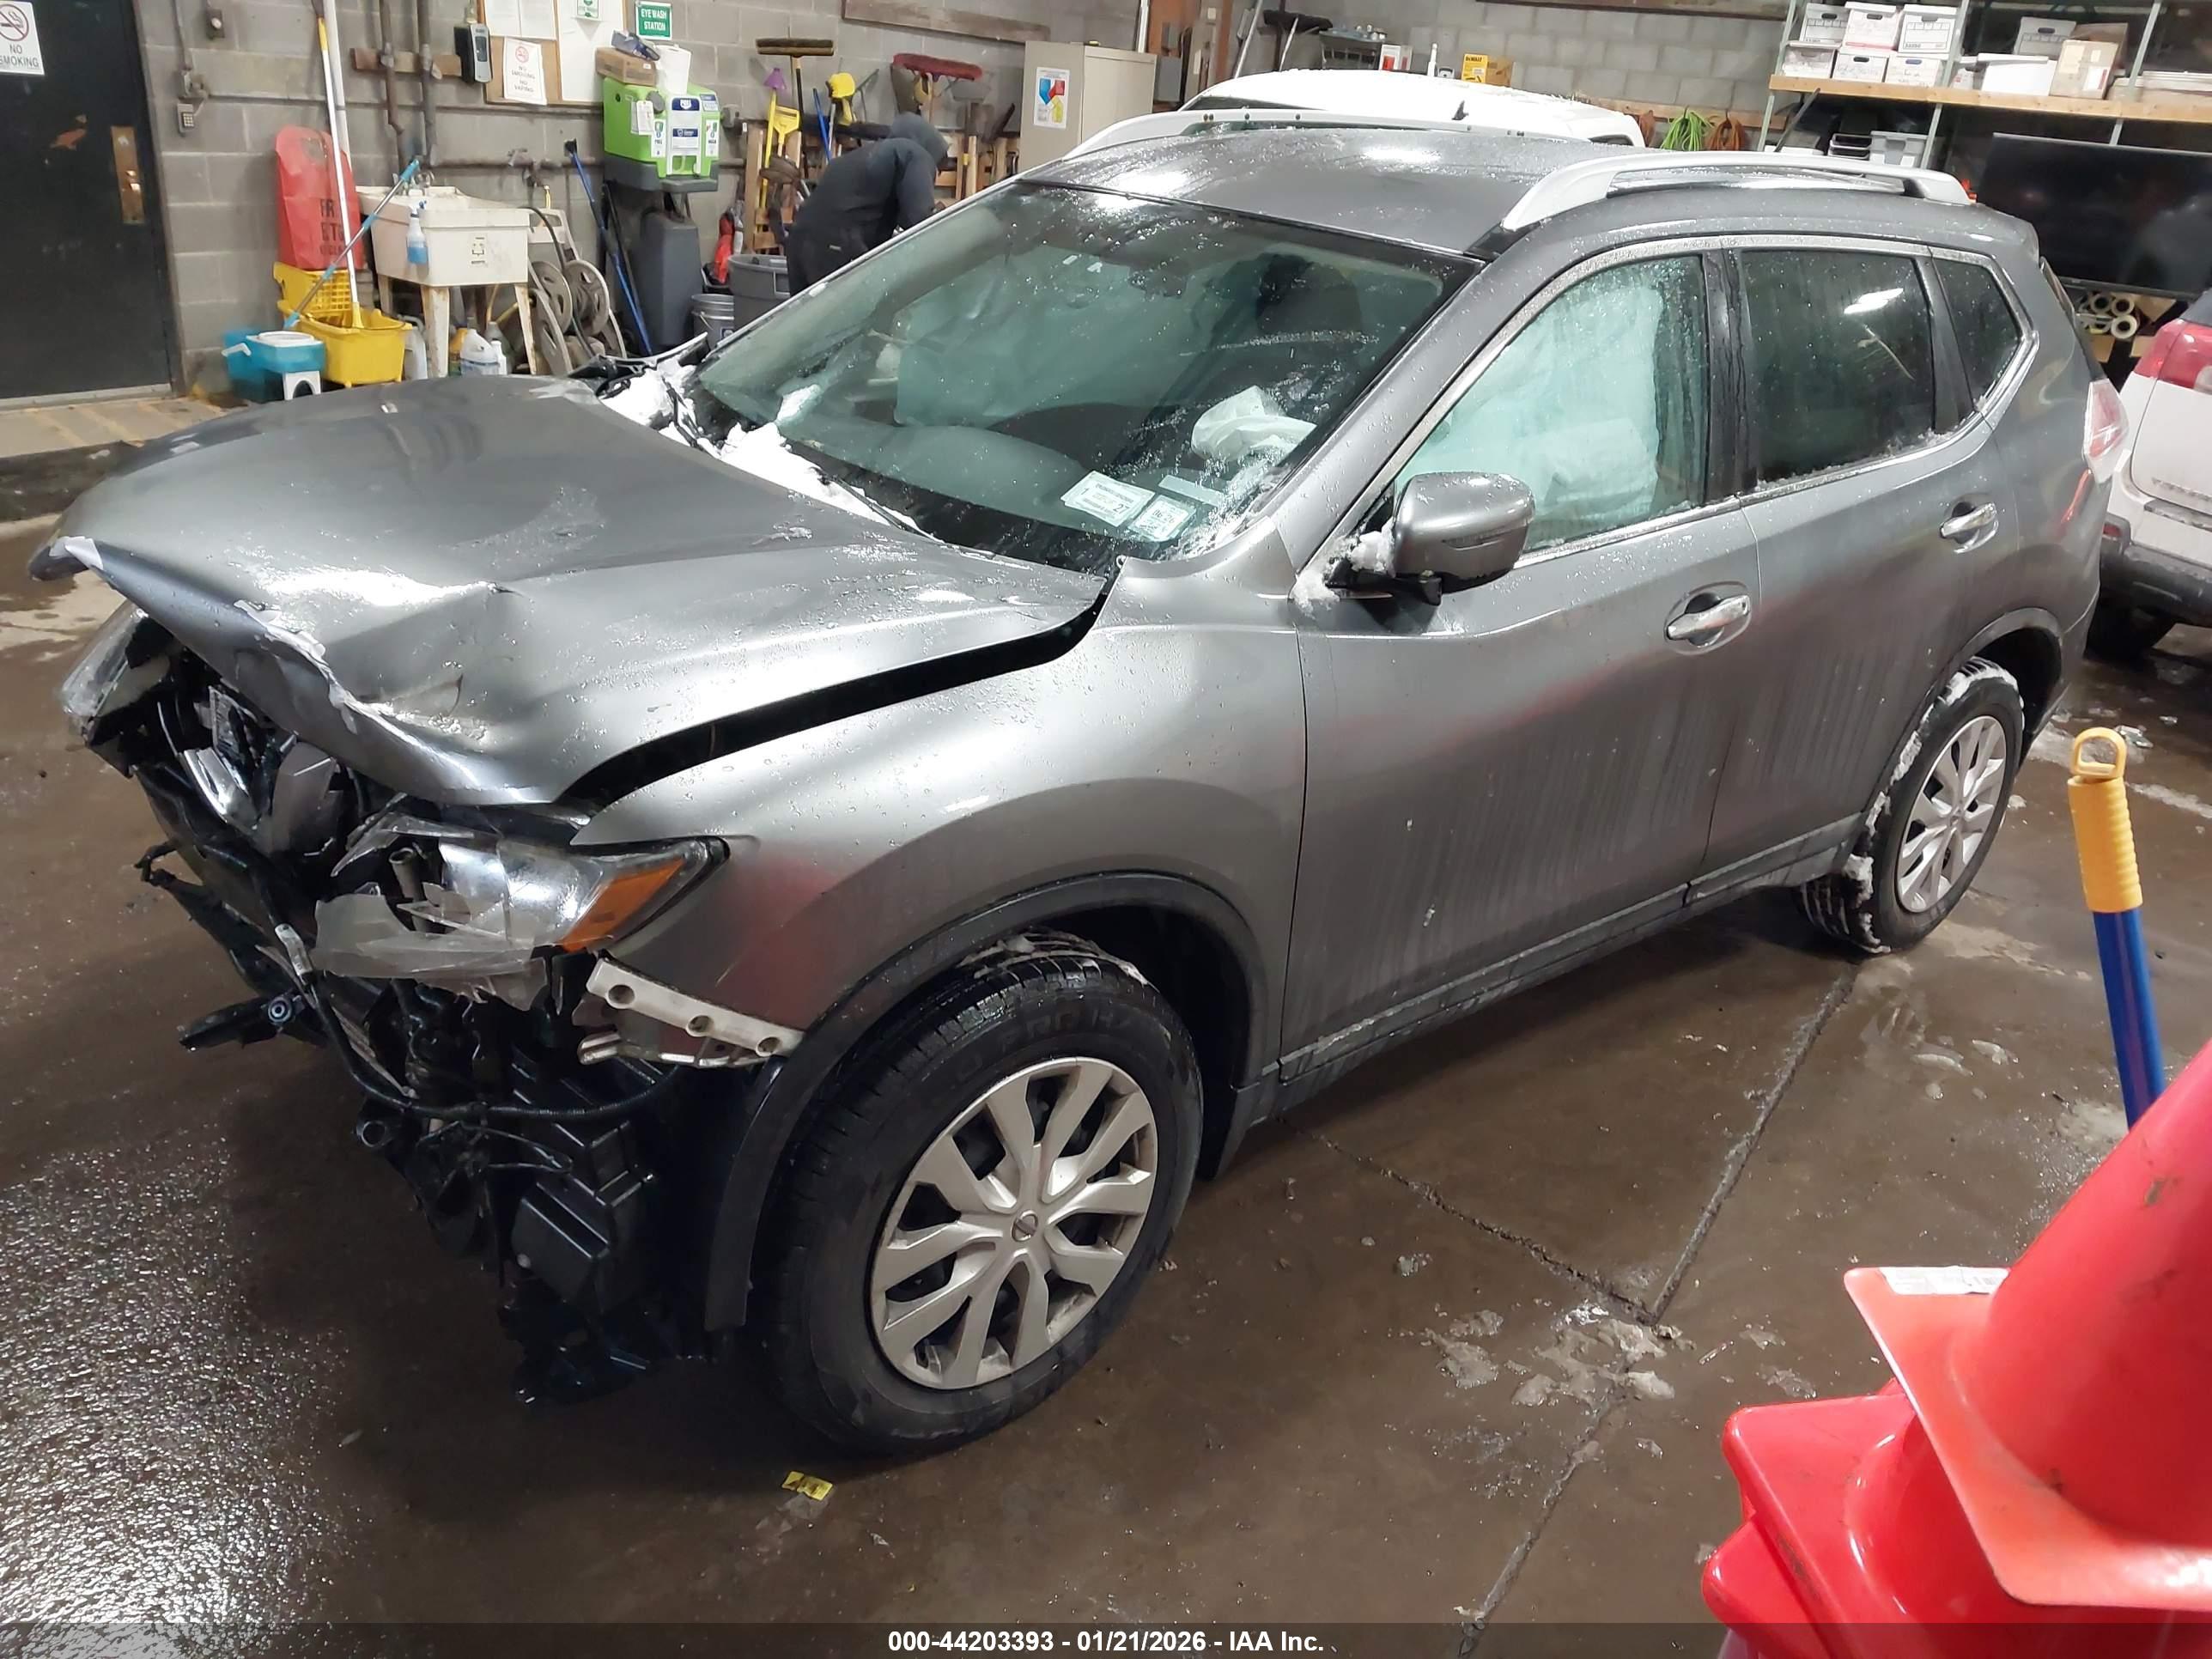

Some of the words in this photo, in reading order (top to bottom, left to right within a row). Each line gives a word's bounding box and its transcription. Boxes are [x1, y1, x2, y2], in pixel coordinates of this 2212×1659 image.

[641, 8, 652, 18] EYE
[652, 9, 667, 20] WASH
[644, 21, 666, 31] STATION
[9, 44, 22, 54] NO
